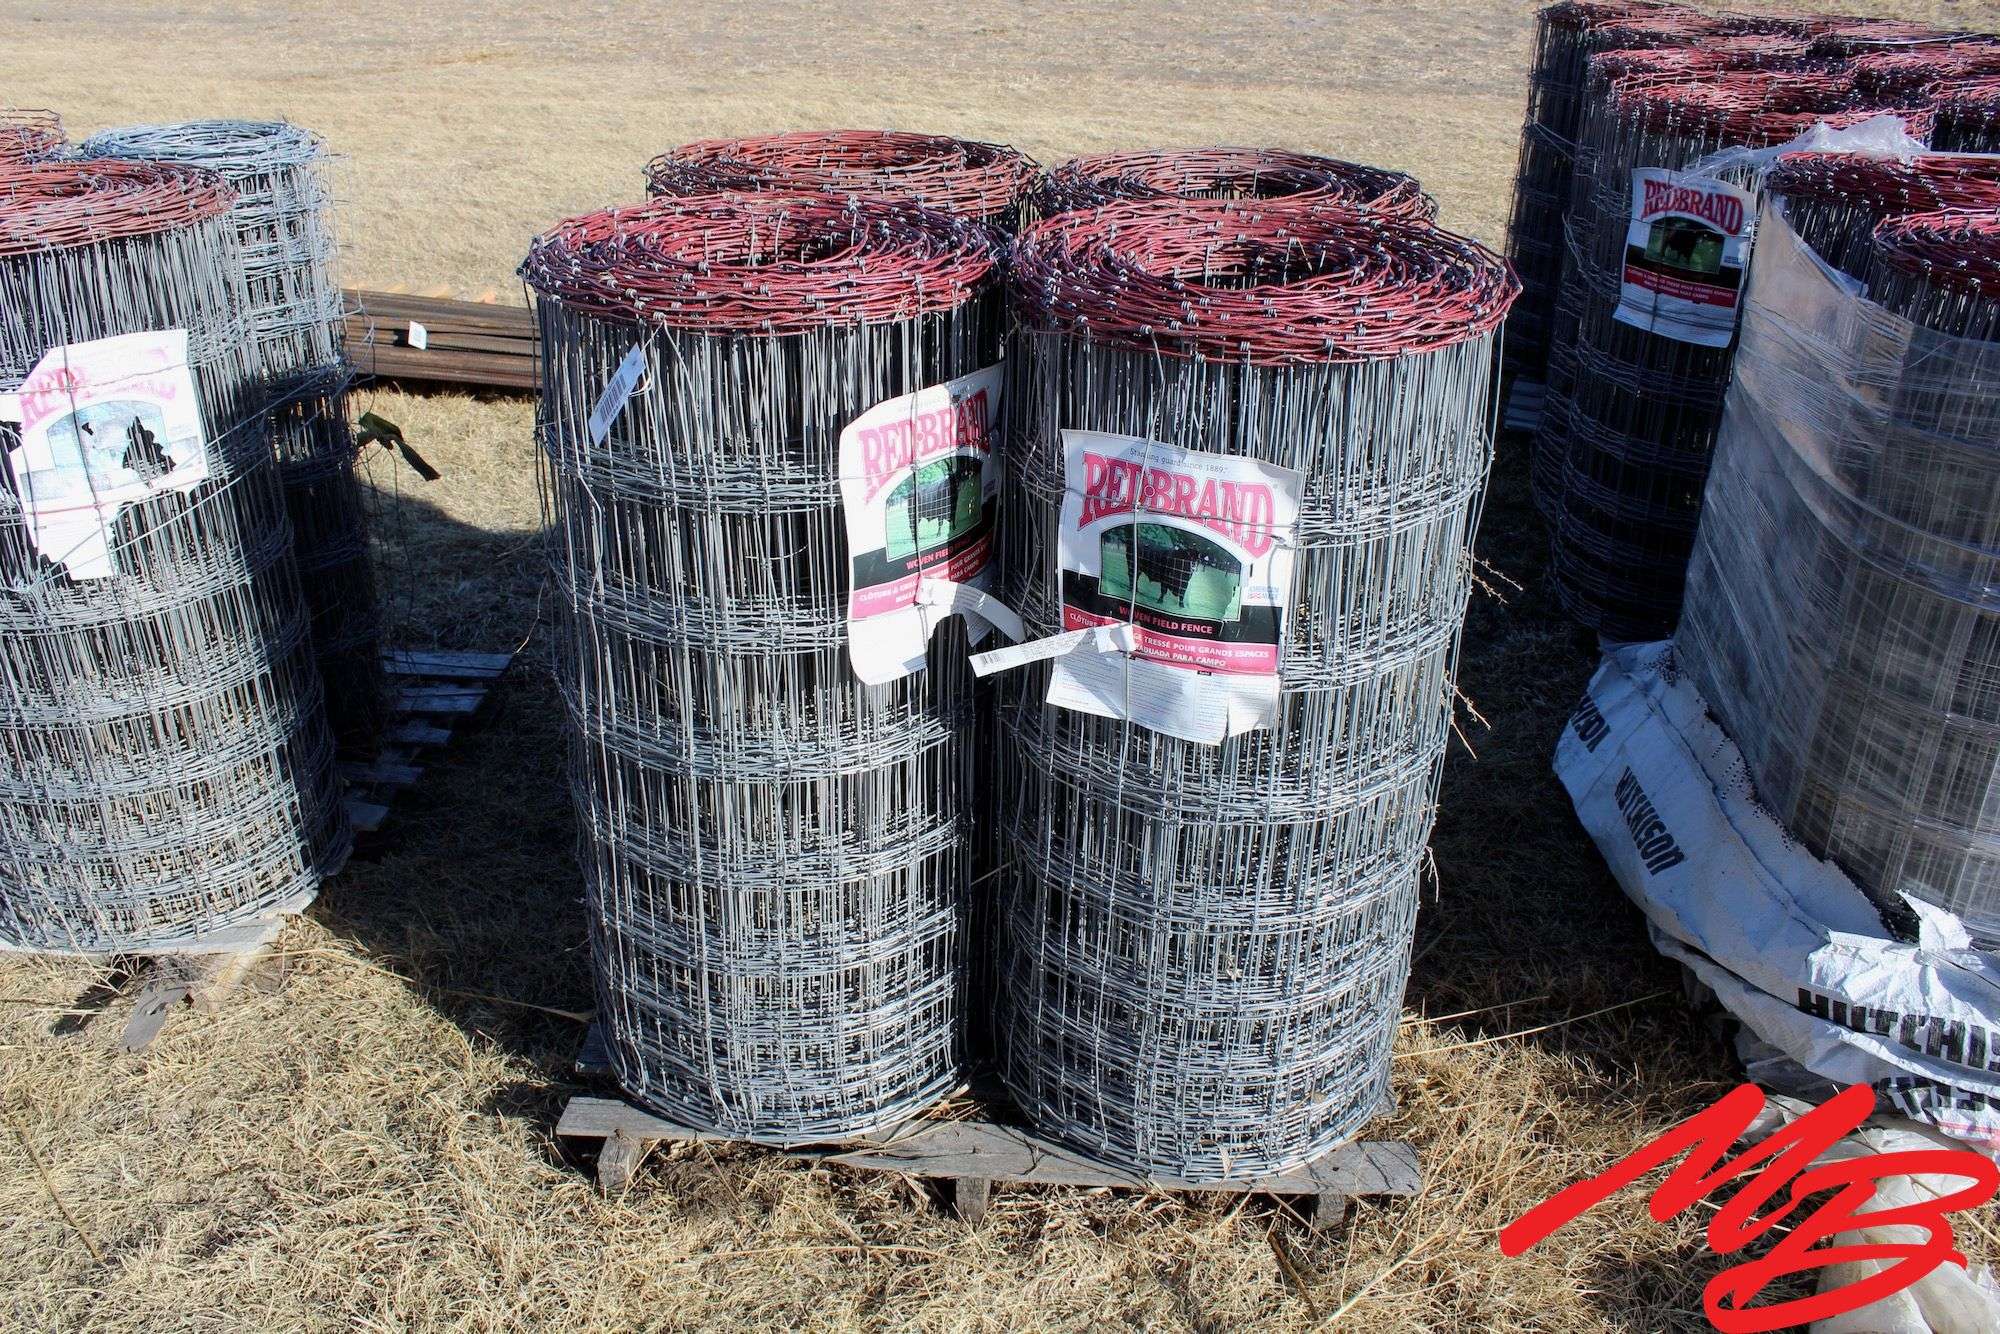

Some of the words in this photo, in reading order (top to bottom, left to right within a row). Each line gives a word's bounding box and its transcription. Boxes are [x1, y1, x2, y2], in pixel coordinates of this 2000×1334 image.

[1640, 178, 1677, 222] RED
[1678, 188, 1744, 239] BRAND
[858, 416, 919, 505] RED
[1077, 450, 1146, 531] RED
[1150, 468, 1276, 559] BRAND
[1153, 616, 1179, 630] FIELD
[1181, 623, 1213, 634] FENCE
[1173, 641, 1195, 653] POUR
[1198, 646, 1233, 658] GRANDS
[1173, 652, 1194, 662] PARA
[1196, 656, 1227, 667] CAMPO
